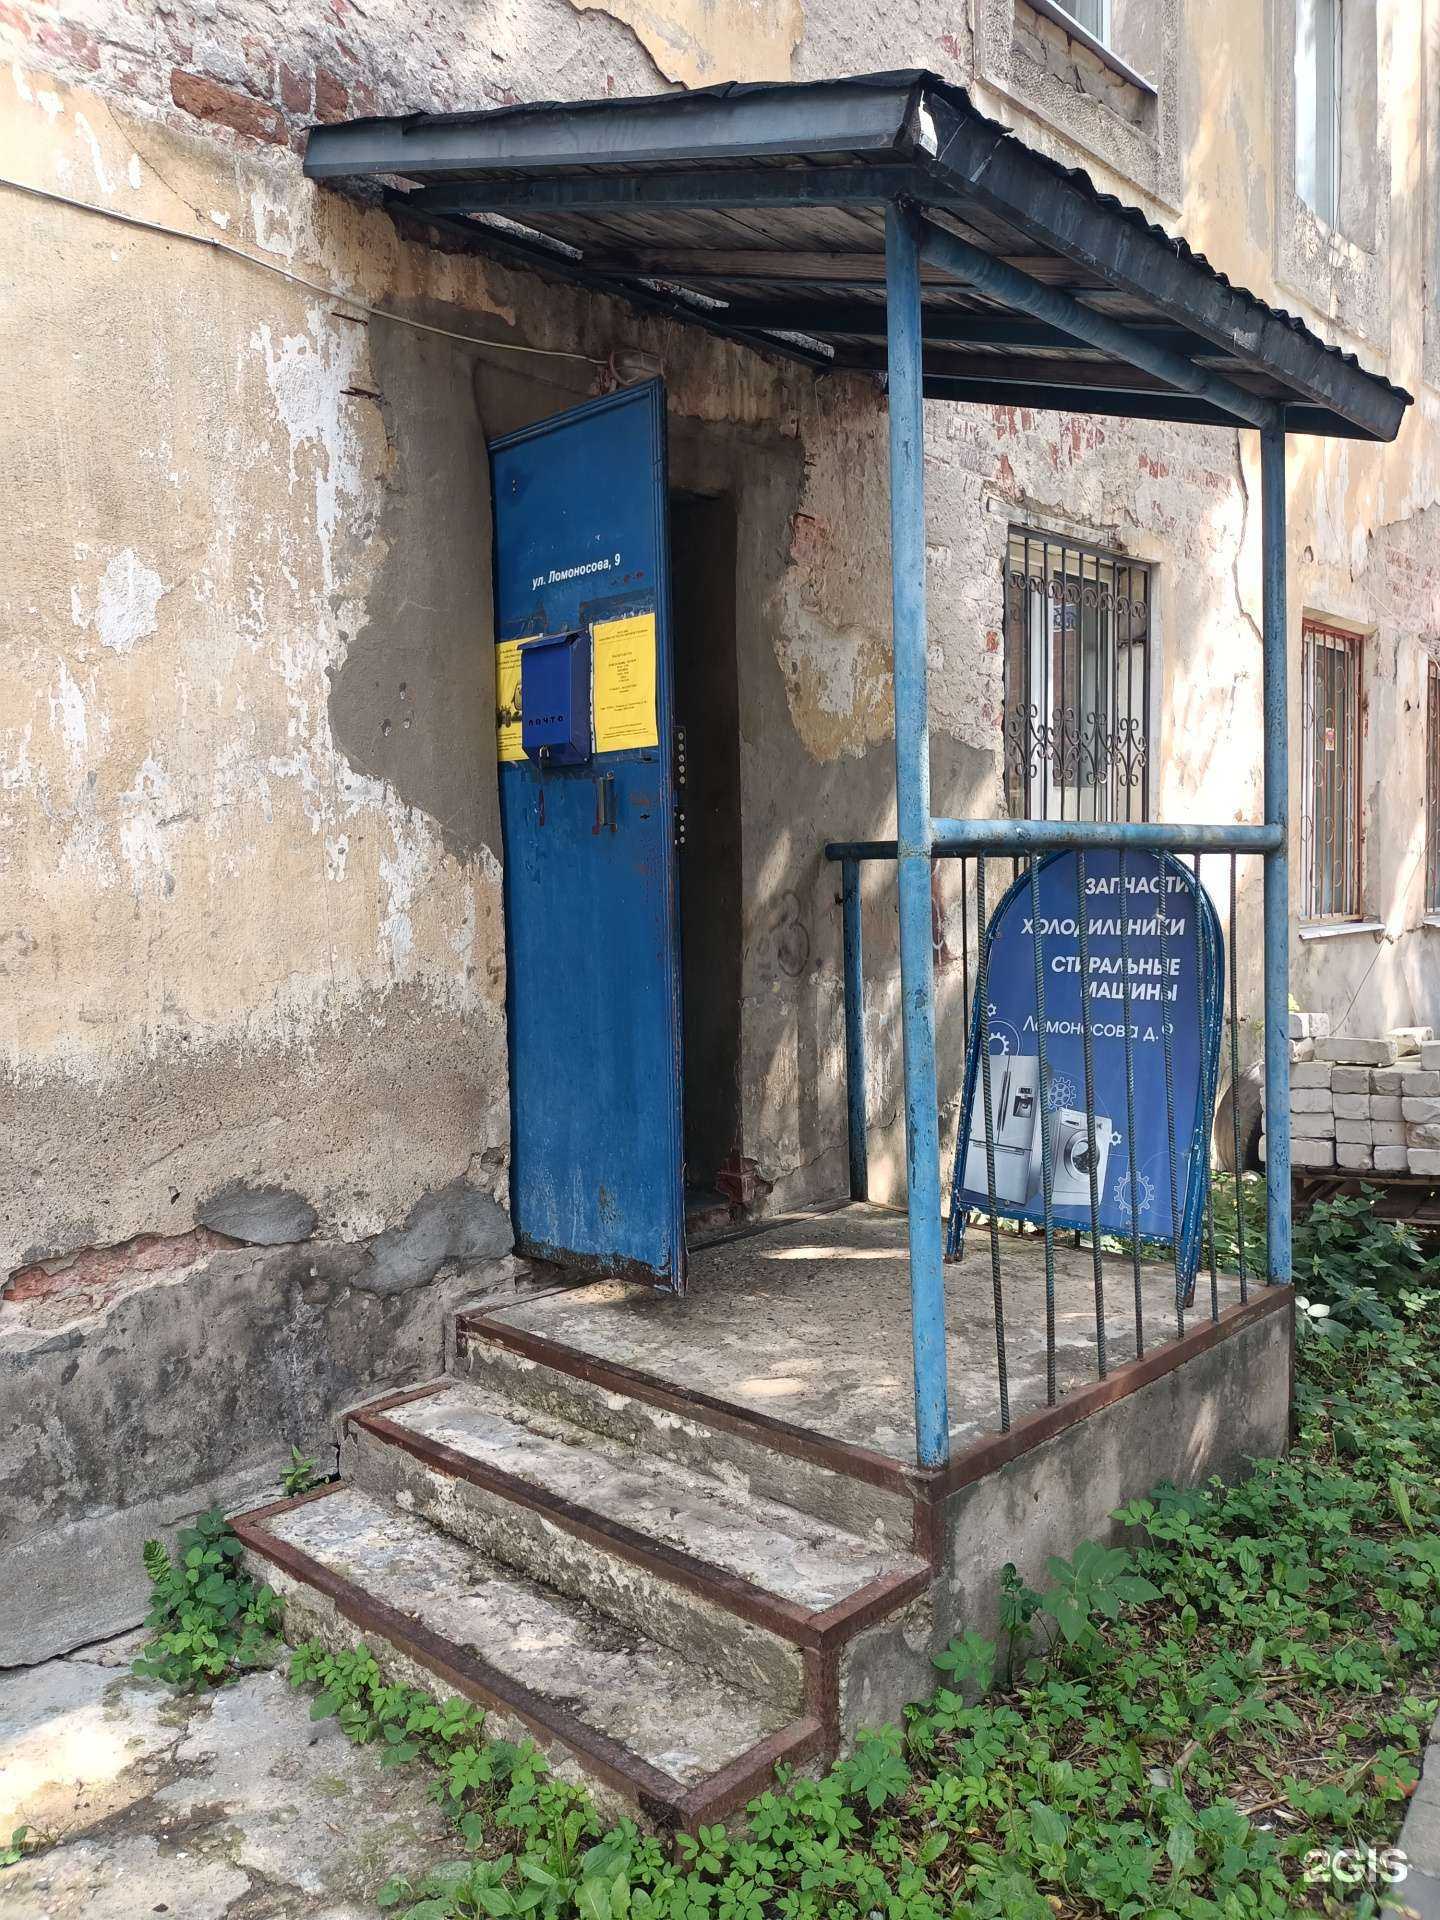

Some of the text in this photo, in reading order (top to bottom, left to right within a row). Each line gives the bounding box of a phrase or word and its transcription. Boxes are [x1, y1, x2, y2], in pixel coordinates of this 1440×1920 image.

[532, 553, 621, 591] ул. Ломоносова, 9
[1020, 918, 1186, 937] ХОЛОИЛНИКИ
[1023, 1015, 1138, 1039] Лмонсова
